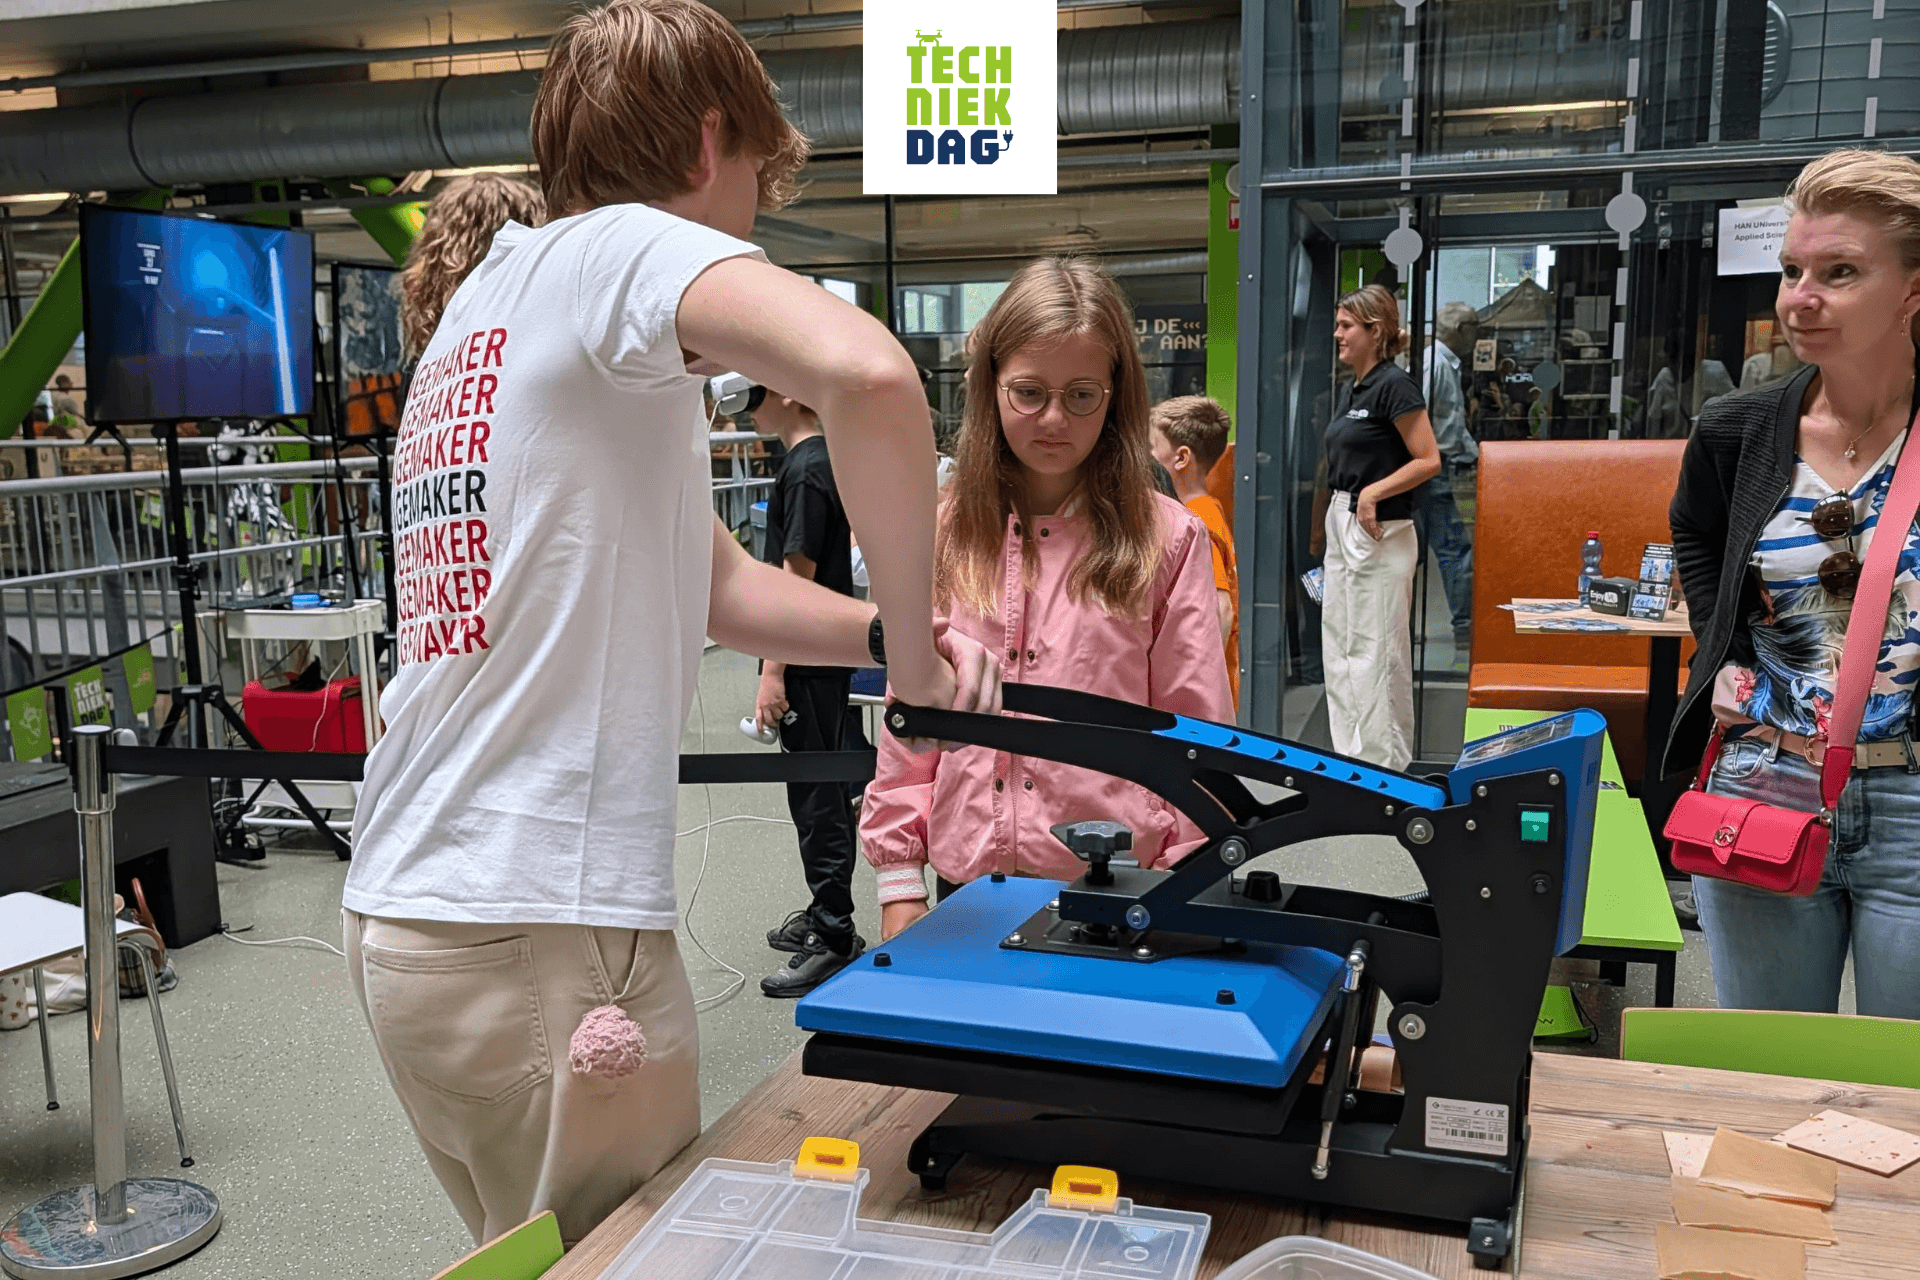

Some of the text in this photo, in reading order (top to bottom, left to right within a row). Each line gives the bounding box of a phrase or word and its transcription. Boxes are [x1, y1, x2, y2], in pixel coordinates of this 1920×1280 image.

[1734, 222, 1752, 230] HAN
[1734, 232, 1765, 242] Applied
[1153, 318, 1181, 334] DE
[409, 328, 507, 402] GEMAKER
[399, 374, 498, 444] GEMAKER
[395, 421, 490, 486] GEMAKER
[393, 469, 487, 532] GEMAKER
[396, 519, 491, 577] GEMAKER
[398, 568, 492, 622] GEMAKER
[74, 679, 102, 700] TECH
